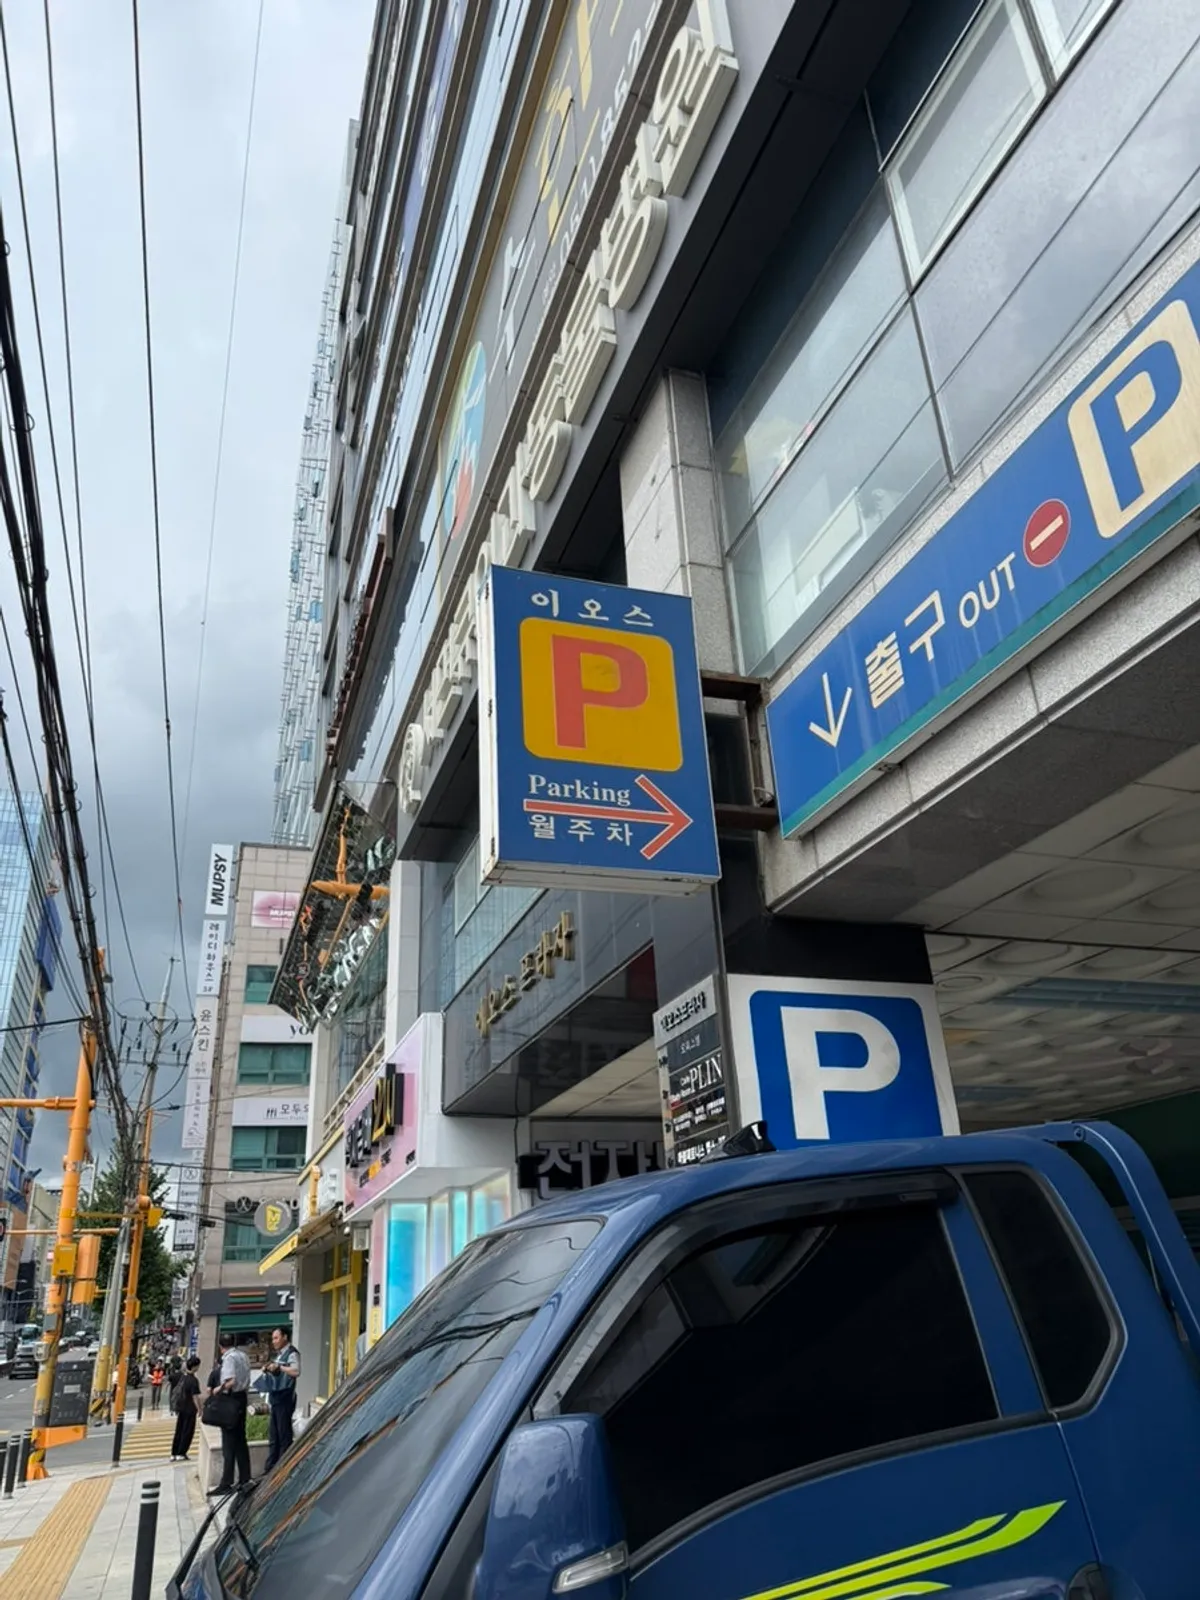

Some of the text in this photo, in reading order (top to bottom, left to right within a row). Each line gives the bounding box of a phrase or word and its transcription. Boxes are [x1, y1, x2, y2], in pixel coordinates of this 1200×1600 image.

[1090, 340, 1182, 513] P
[531, 589, 654, 627] 이오스
[865, 552, 1020, 709] 출구 OUT
[552, 634, 649, 750] P
[529, 774, 630, 806] Parking
[529, 814, 634, 847] 월주차
[210, 854, 228, 907] MUPSY
[203, 923, 220, 982] 레이디하우스
[197, 1009, 213, 1052] 윤스킨
[290, 1024, 310, 1039] yo
[690, 1053, 723, 1094] PLIN
[780, 1006, 901, 1140] P
[536, 1141, 664, 1200] 전자
